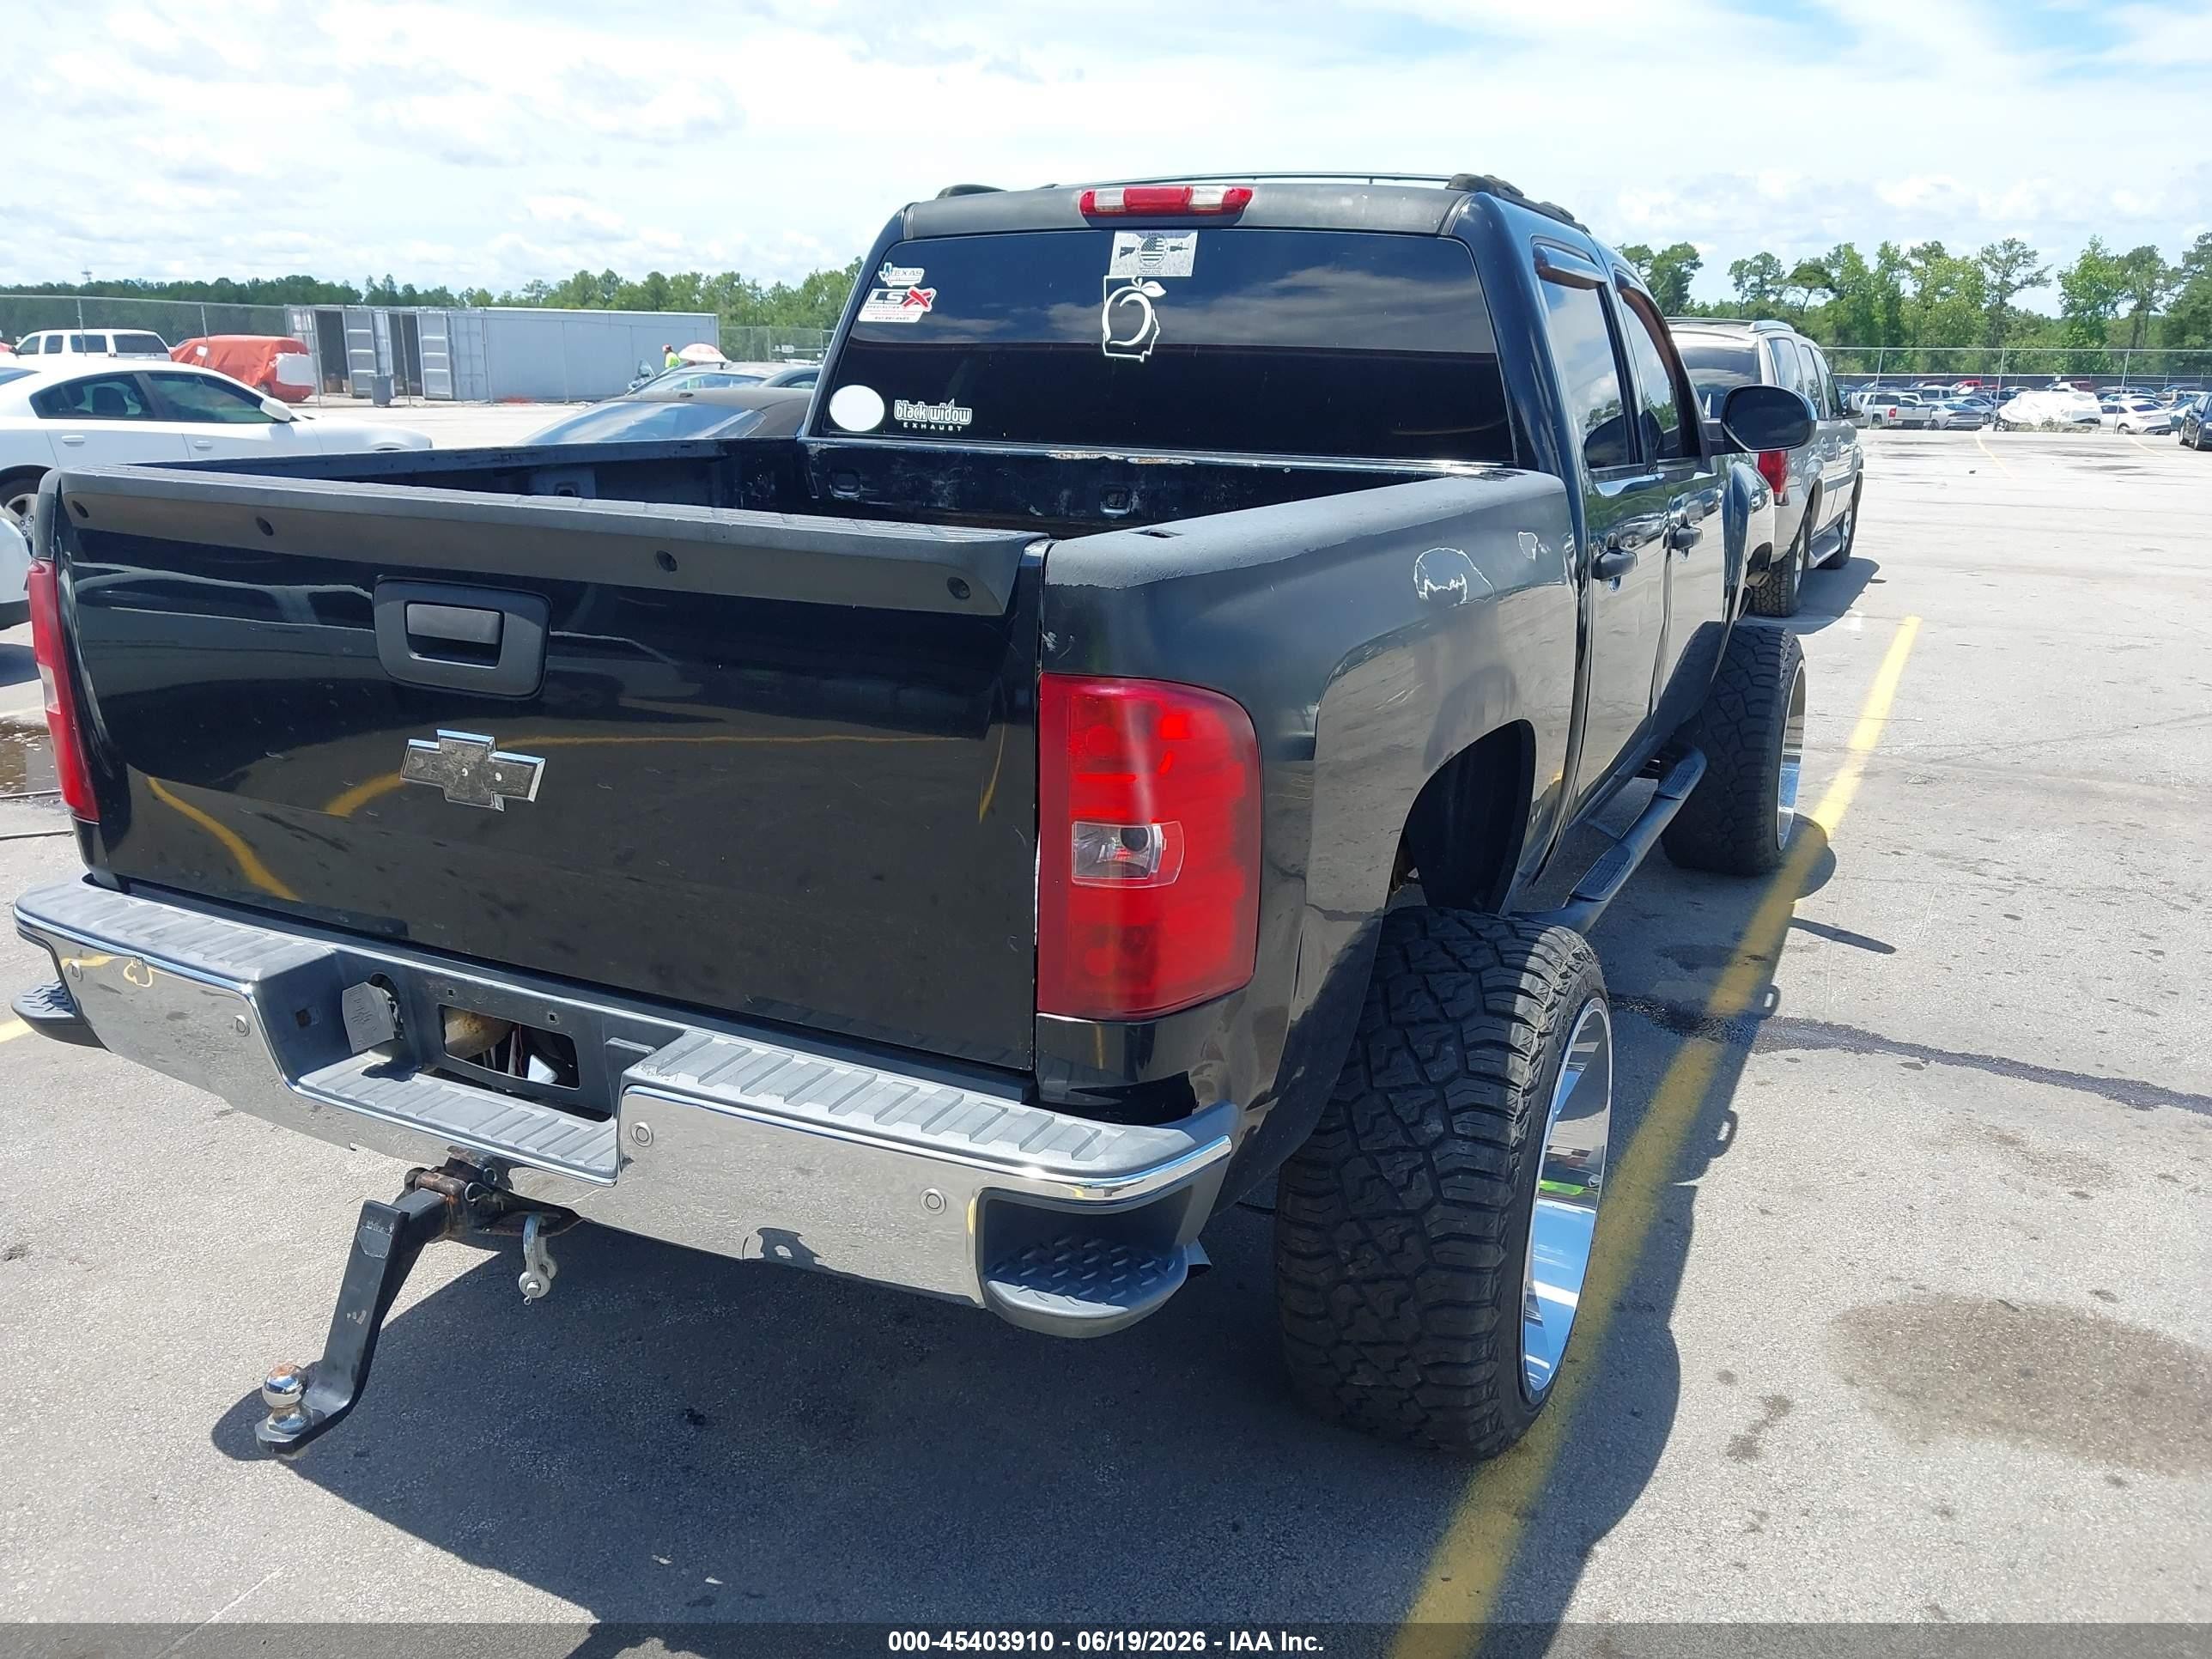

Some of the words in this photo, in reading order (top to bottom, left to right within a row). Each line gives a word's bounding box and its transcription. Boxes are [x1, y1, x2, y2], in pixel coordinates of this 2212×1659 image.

[868, 289, 933, 309] LSX
[894, 399, 927, 422] black
[928, 398, 972, 424] widow
[903, 422, 963, 432] EXHAUST
